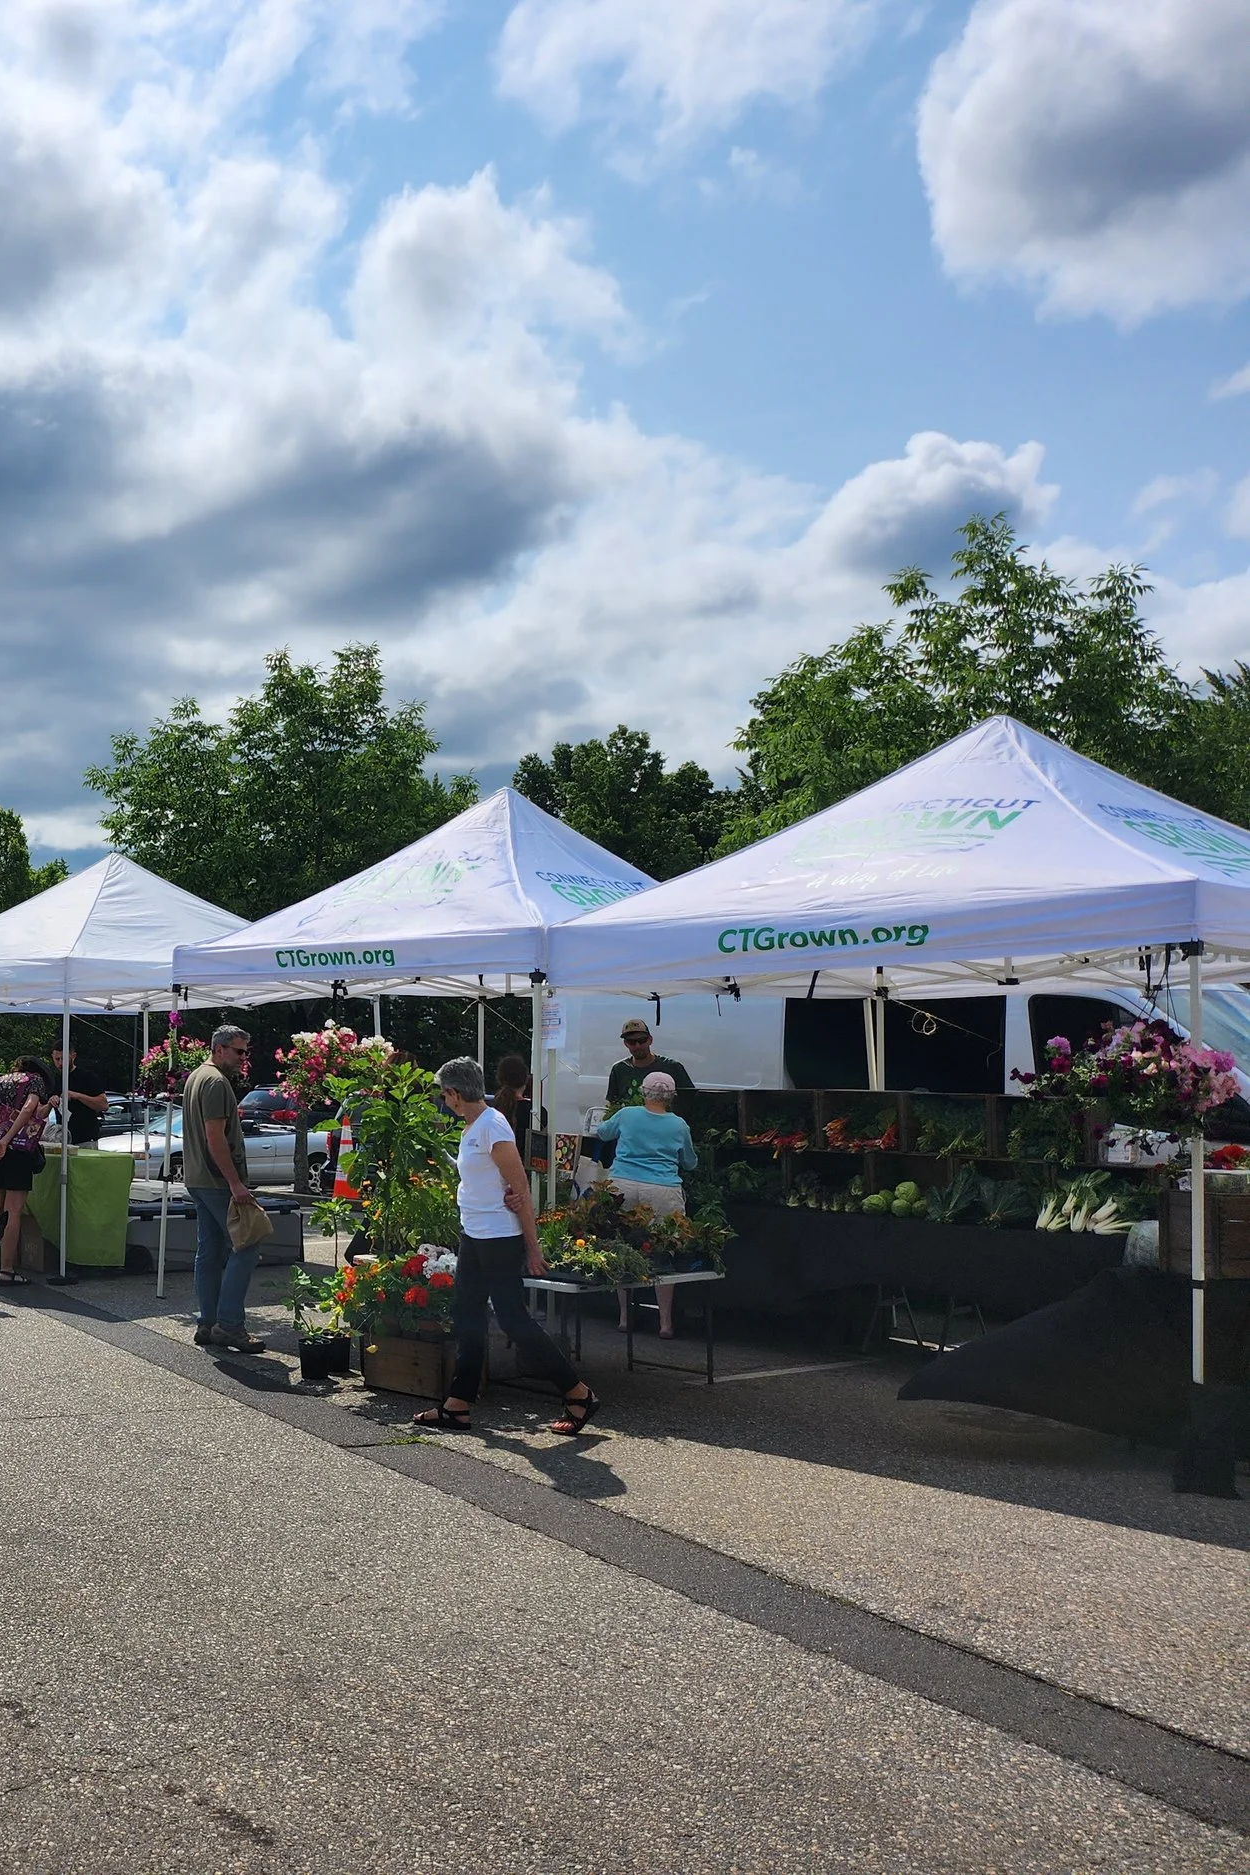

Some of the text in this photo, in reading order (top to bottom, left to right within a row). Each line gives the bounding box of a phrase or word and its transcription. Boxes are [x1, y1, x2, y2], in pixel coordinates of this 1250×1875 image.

[535, 871, 646, 892] CONNECTICUT
[717, 924, 929, 953] CTGrown.org
[275, 949, 395, 968] CTGrown.org
